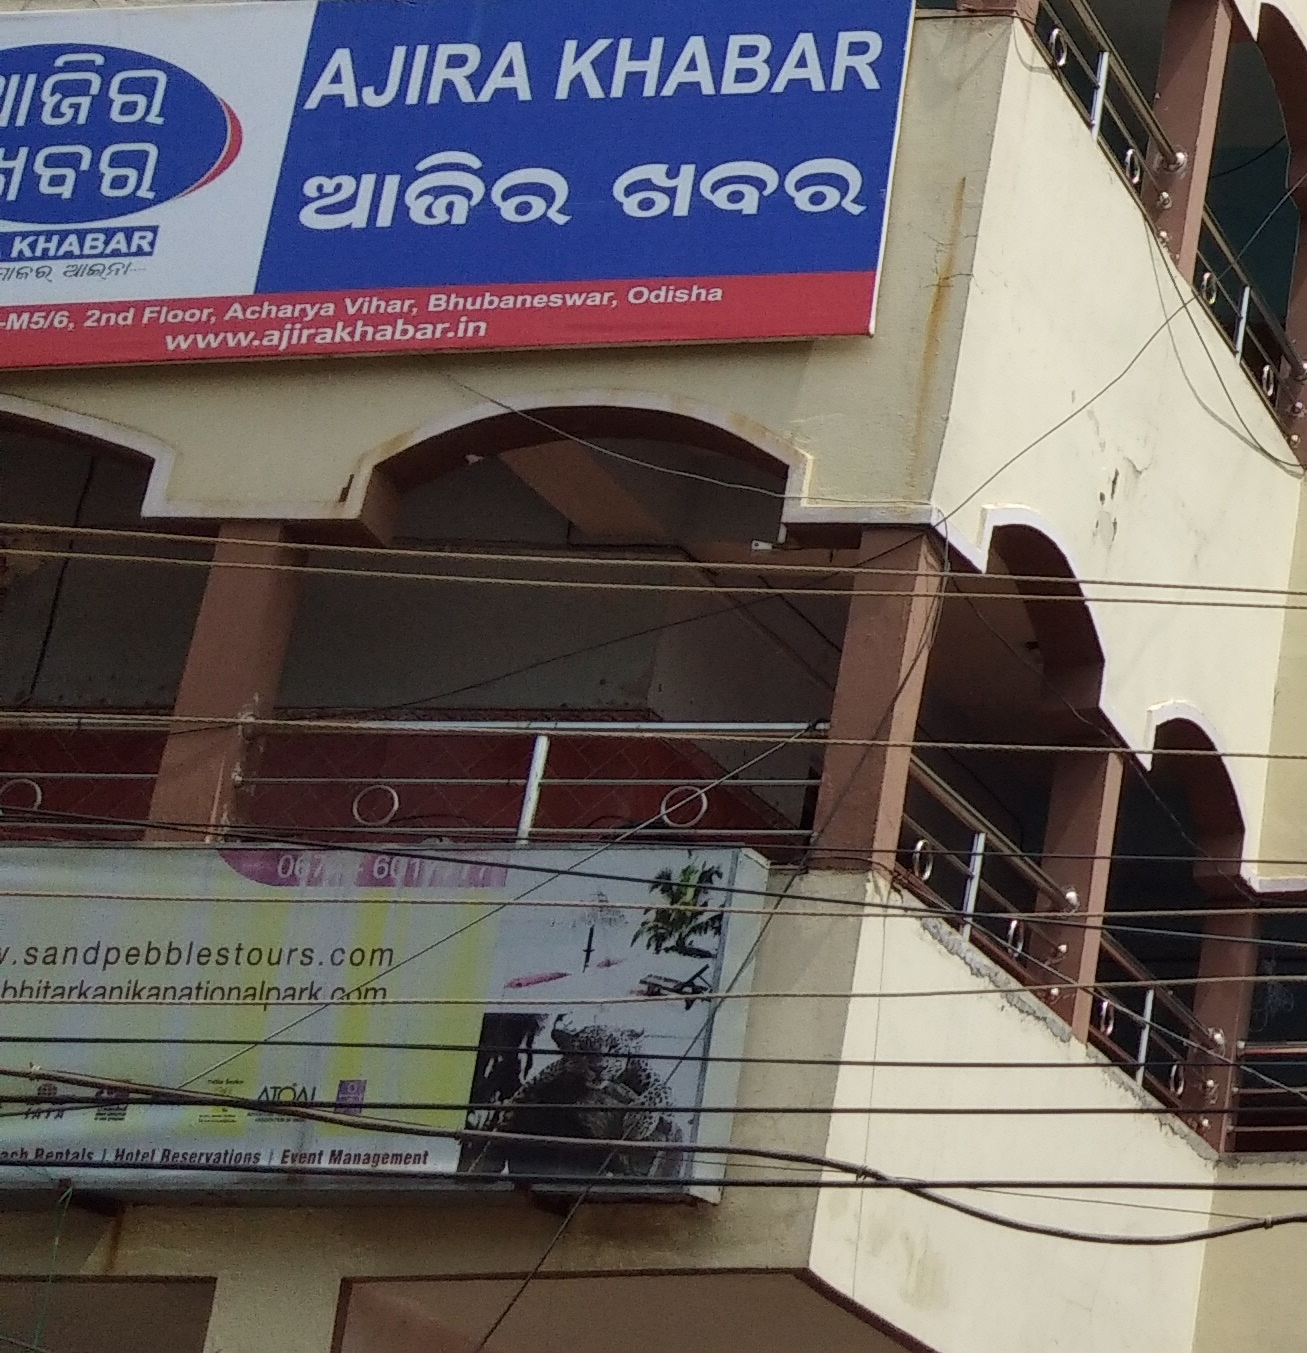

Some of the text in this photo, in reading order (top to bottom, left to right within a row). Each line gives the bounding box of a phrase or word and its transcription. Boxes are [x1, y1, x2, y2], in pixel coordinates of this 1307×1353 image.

[303, 30, 883, 109] AJIRA KHABAR
[299, 150, 868, 230] ଆଜିର ଖବର
[10, 231, 154, 258] KHABAR
[84, 308, 135, 327] 2nd
[142, 303, 217, 325] Floor,
[224, 298, 335, 321] Acharya
[344, 294, 418, 315] Vihar,
[428, 287, 618, 311] Bhubaneswar,
[627, 284, 723, 304] Odisha
[165, 316, 488, 351] www.ajirakhabar.in
[160, 1148, 261, 1165] Reservations
[280, 1150, 325, 1165] Event
[328, 1150, 430, 1168] Management
